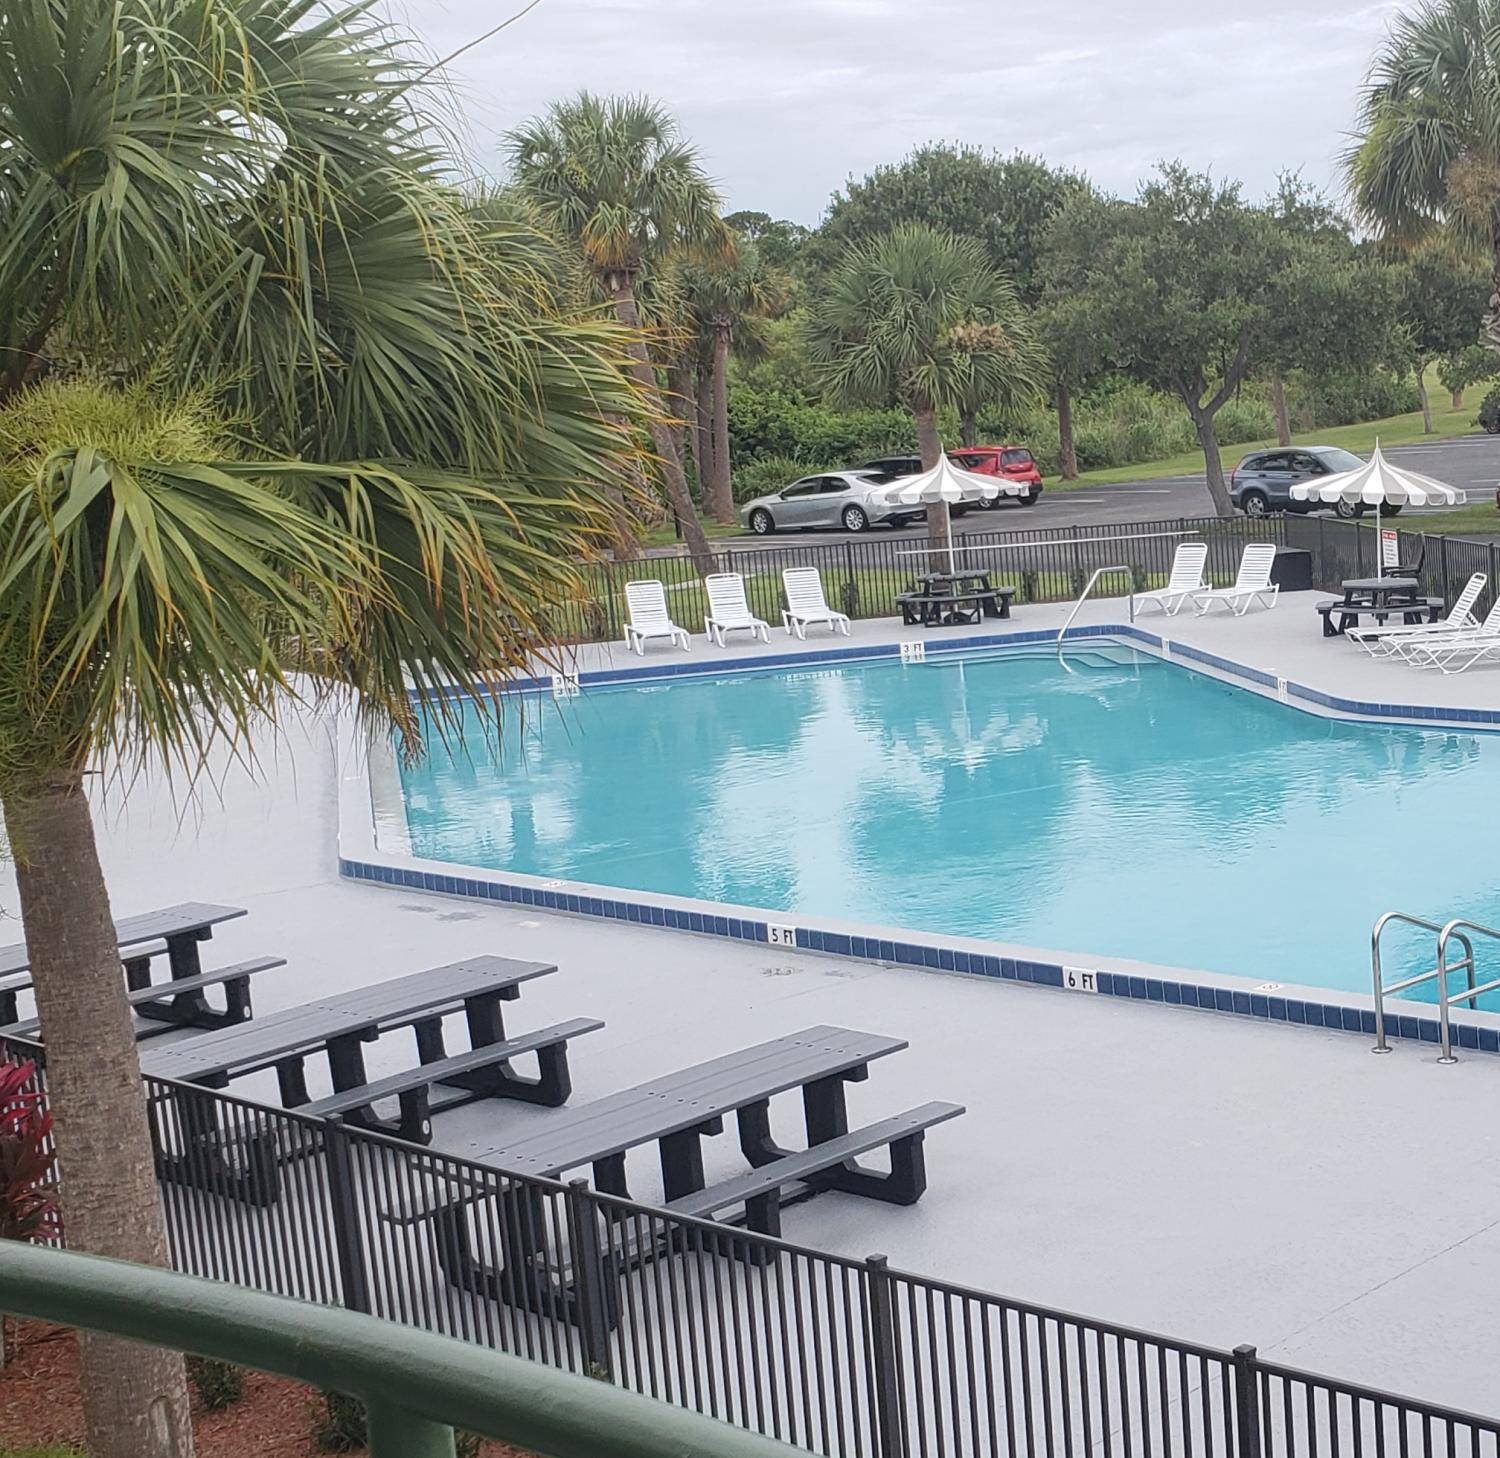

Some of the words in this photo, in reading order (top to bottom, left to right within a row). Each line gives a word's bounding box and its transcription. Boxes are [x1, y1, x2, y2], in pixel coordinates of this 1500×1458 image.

[903, 645, 909, 653] 3
[913, 643, 922, 652] FT
[556, 677, 562, 685] 3
[772, 928, 778, 942] 5
[784, 929, 793, 944] FT
[1068, 972, 1076, 987] 6
[1082, 974, 1093, 990] FT
